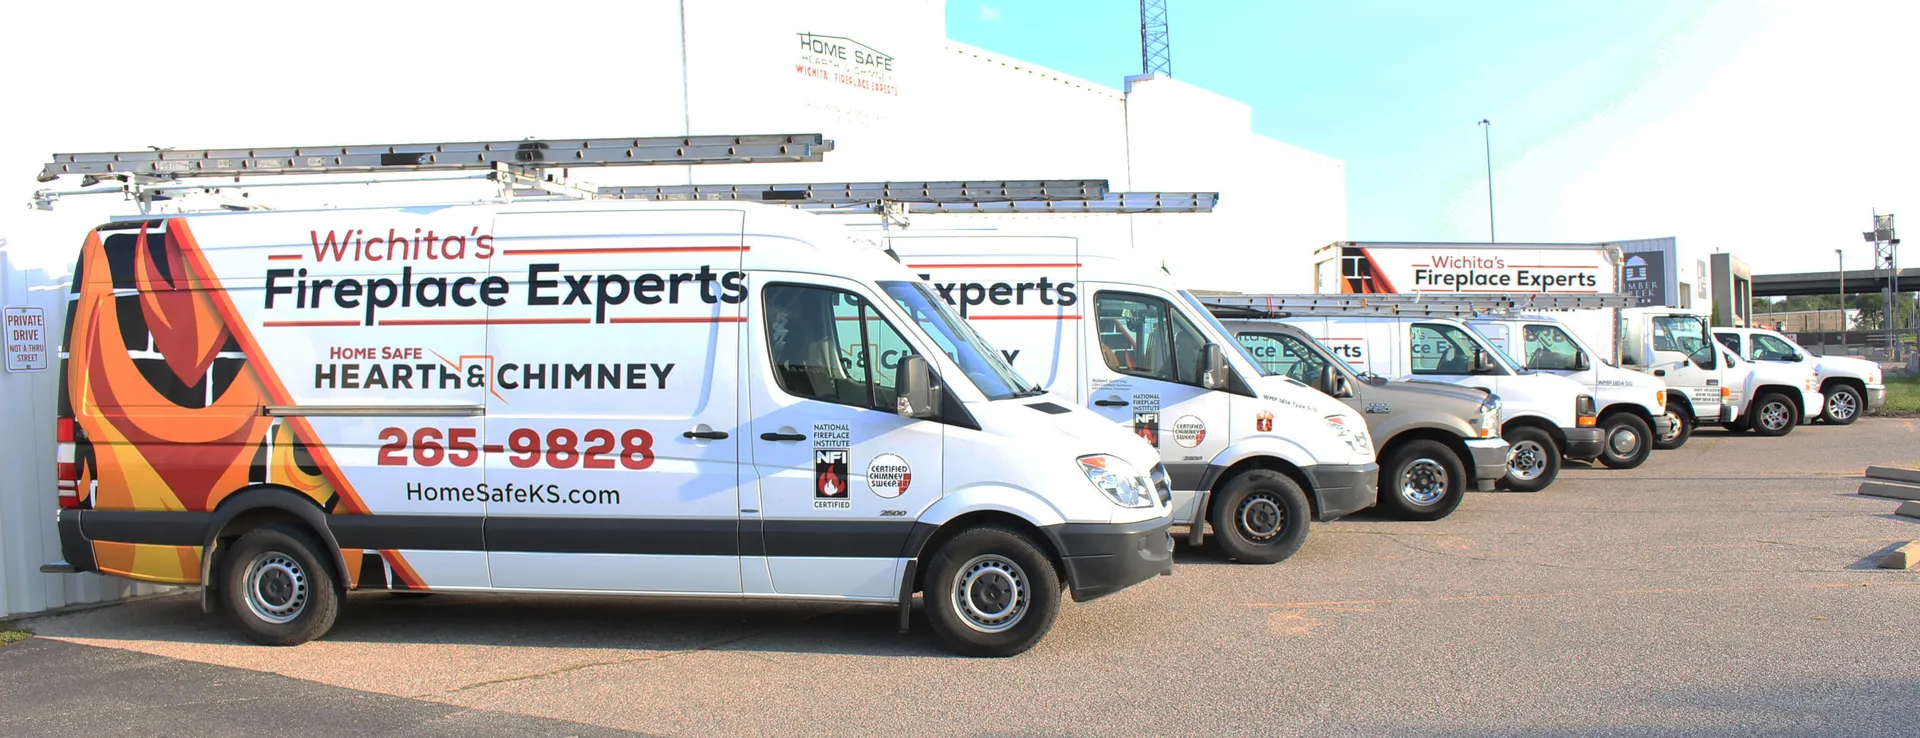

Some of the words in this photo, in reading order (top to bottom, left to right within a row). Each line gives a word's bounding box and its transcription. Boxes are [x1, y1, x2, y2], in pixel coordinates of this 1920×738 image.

[800, 32, 847, 60] HOME
[855, 50, 893, 72] SAFE
[310, 226, 495, 262] Wichita's
[1432, 255, 1505, 269] Wichita's
[1414, 269, 1511, 291] Fireplace
[1518, 269, 1597, 292] Experts
[1623, 281, 1658, 290] IMBER
[263, 266, 509, 326] Fireplace
[527, 263, 749, 324] Experts
[916, 274, 1078, 319] xperts
[7, 315, 43, 326] PRIVATE
[13, 329, 39, 341] DRIVE
[9, 344, 21, 352] NOT
[23, 344, 27, 352] A
[29, 344, 44, 352] THRU
[330, 346, 376, 360] HOME
[381, 345, 423, 360] SAFE
[16, 354, 38, 362] STREET
[466, 363, 486, 388] &
[497, 362, 676, 390] CHIMNEY
[1135, 413, 1158, 423] NFI
[377, 425, 655, 470] 265-9828
[817, 451, 847, 464] NFI
[406, 482, 621, 504] HomeSafeKS.com
[814, 501, 850, 509] CERTIFIED
